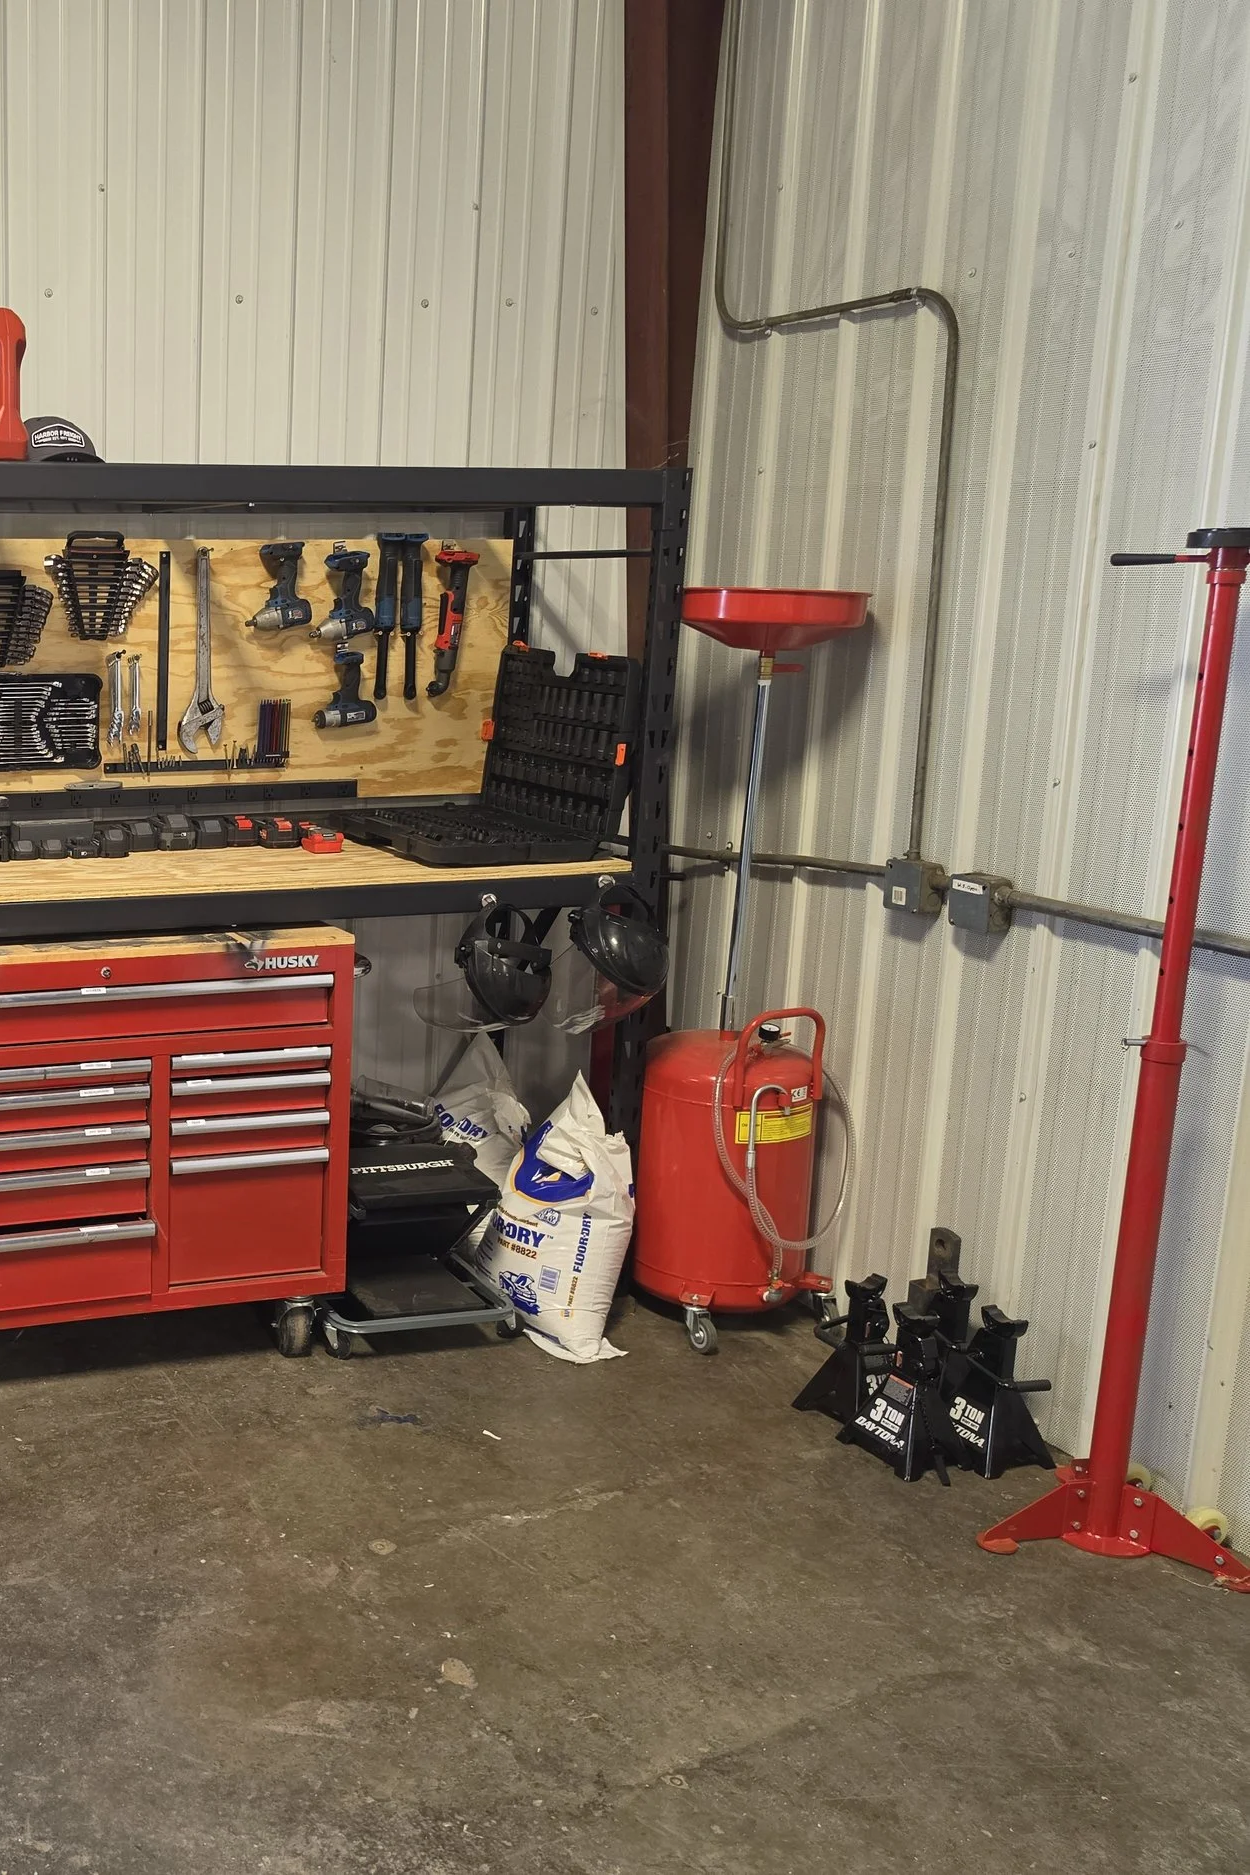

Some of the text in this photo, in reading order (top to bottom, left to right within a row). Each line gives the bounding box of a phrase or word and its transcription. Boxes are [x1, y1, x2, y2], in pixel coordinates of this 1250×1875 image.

[34, 430, 81, 440] HARBOR FREIGHT
[265, 955, 319, 969] HUSKY
[350, 1160, 454, 1175] PITTSBURGH
[511, 1243, 537, 1259] #8822
[870, 1398, 905, 1426] 3 TON
[950, 1396, 985, 1424] 3 TON
[855, 1416, 904, 1448] DAYTONA
